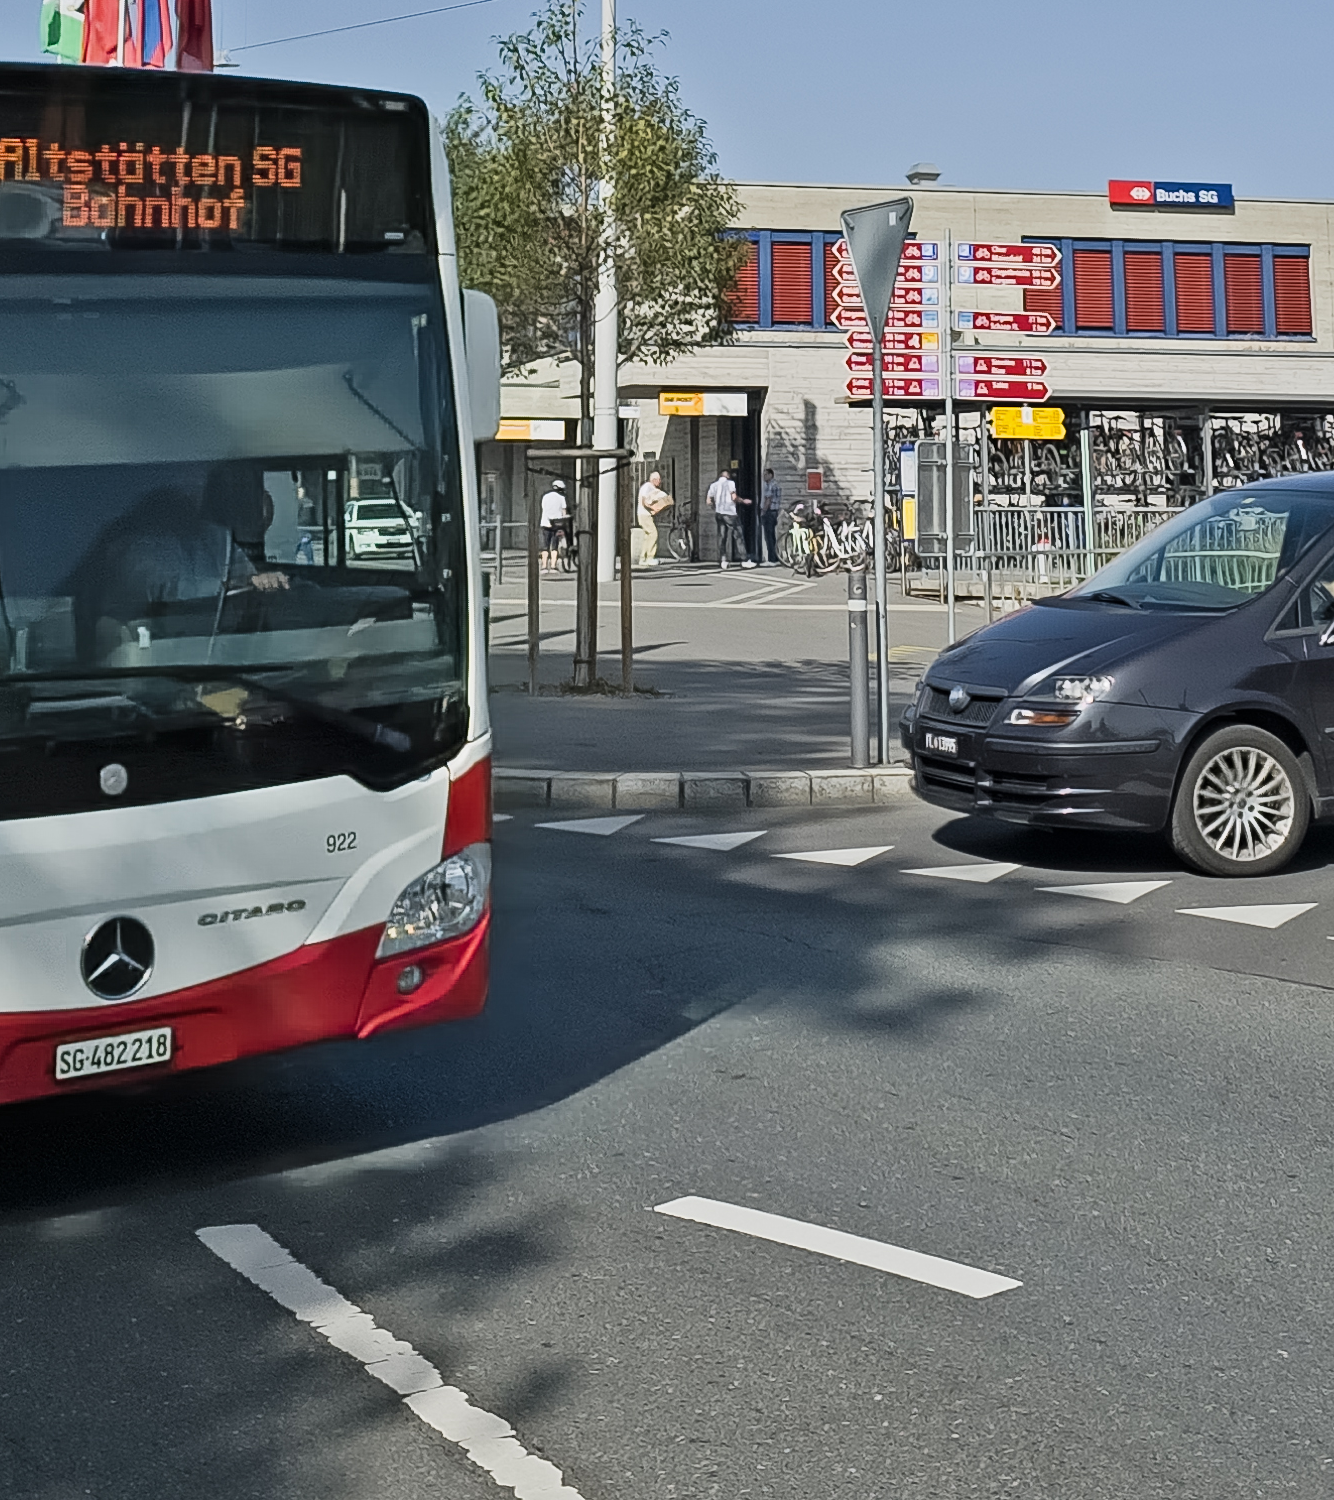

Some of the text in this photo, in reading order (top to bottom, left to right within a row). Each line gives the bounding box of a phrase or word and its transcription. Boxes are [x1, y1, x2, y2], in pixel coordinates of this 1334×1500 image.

[252, 145, 302, 188] SG
[62, 184, 245, 230] Bahnhof
[1155, 188, 1219, 204] Buchs SG
[326, 831, 357, 854] 922
